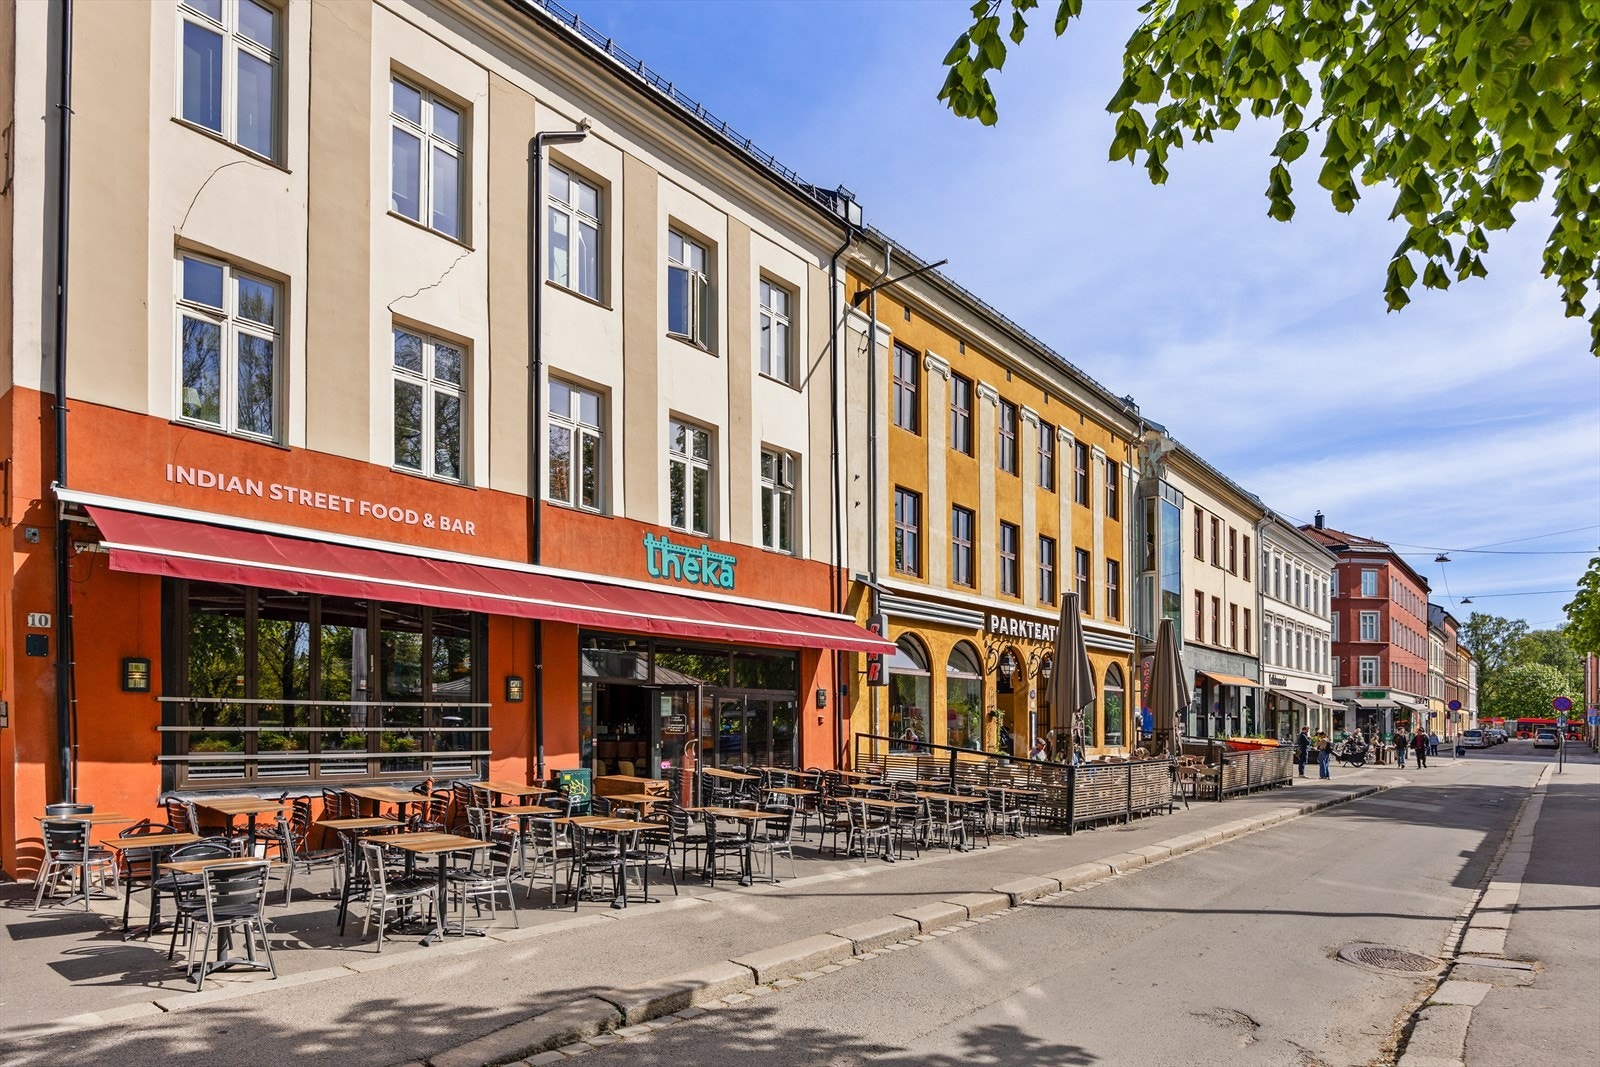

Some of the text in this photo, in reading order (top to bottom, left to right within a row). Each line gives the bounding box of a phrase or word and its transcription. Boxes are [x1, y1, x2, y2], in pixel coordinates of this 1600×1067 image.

[166, 463, 476, 536] INDIAN STREET FOOD & BAR
[643, 532, 736, 589] theka
[30, 614, 49, 627] 10
[990, 614, 1059, 641] PARKTEAT
